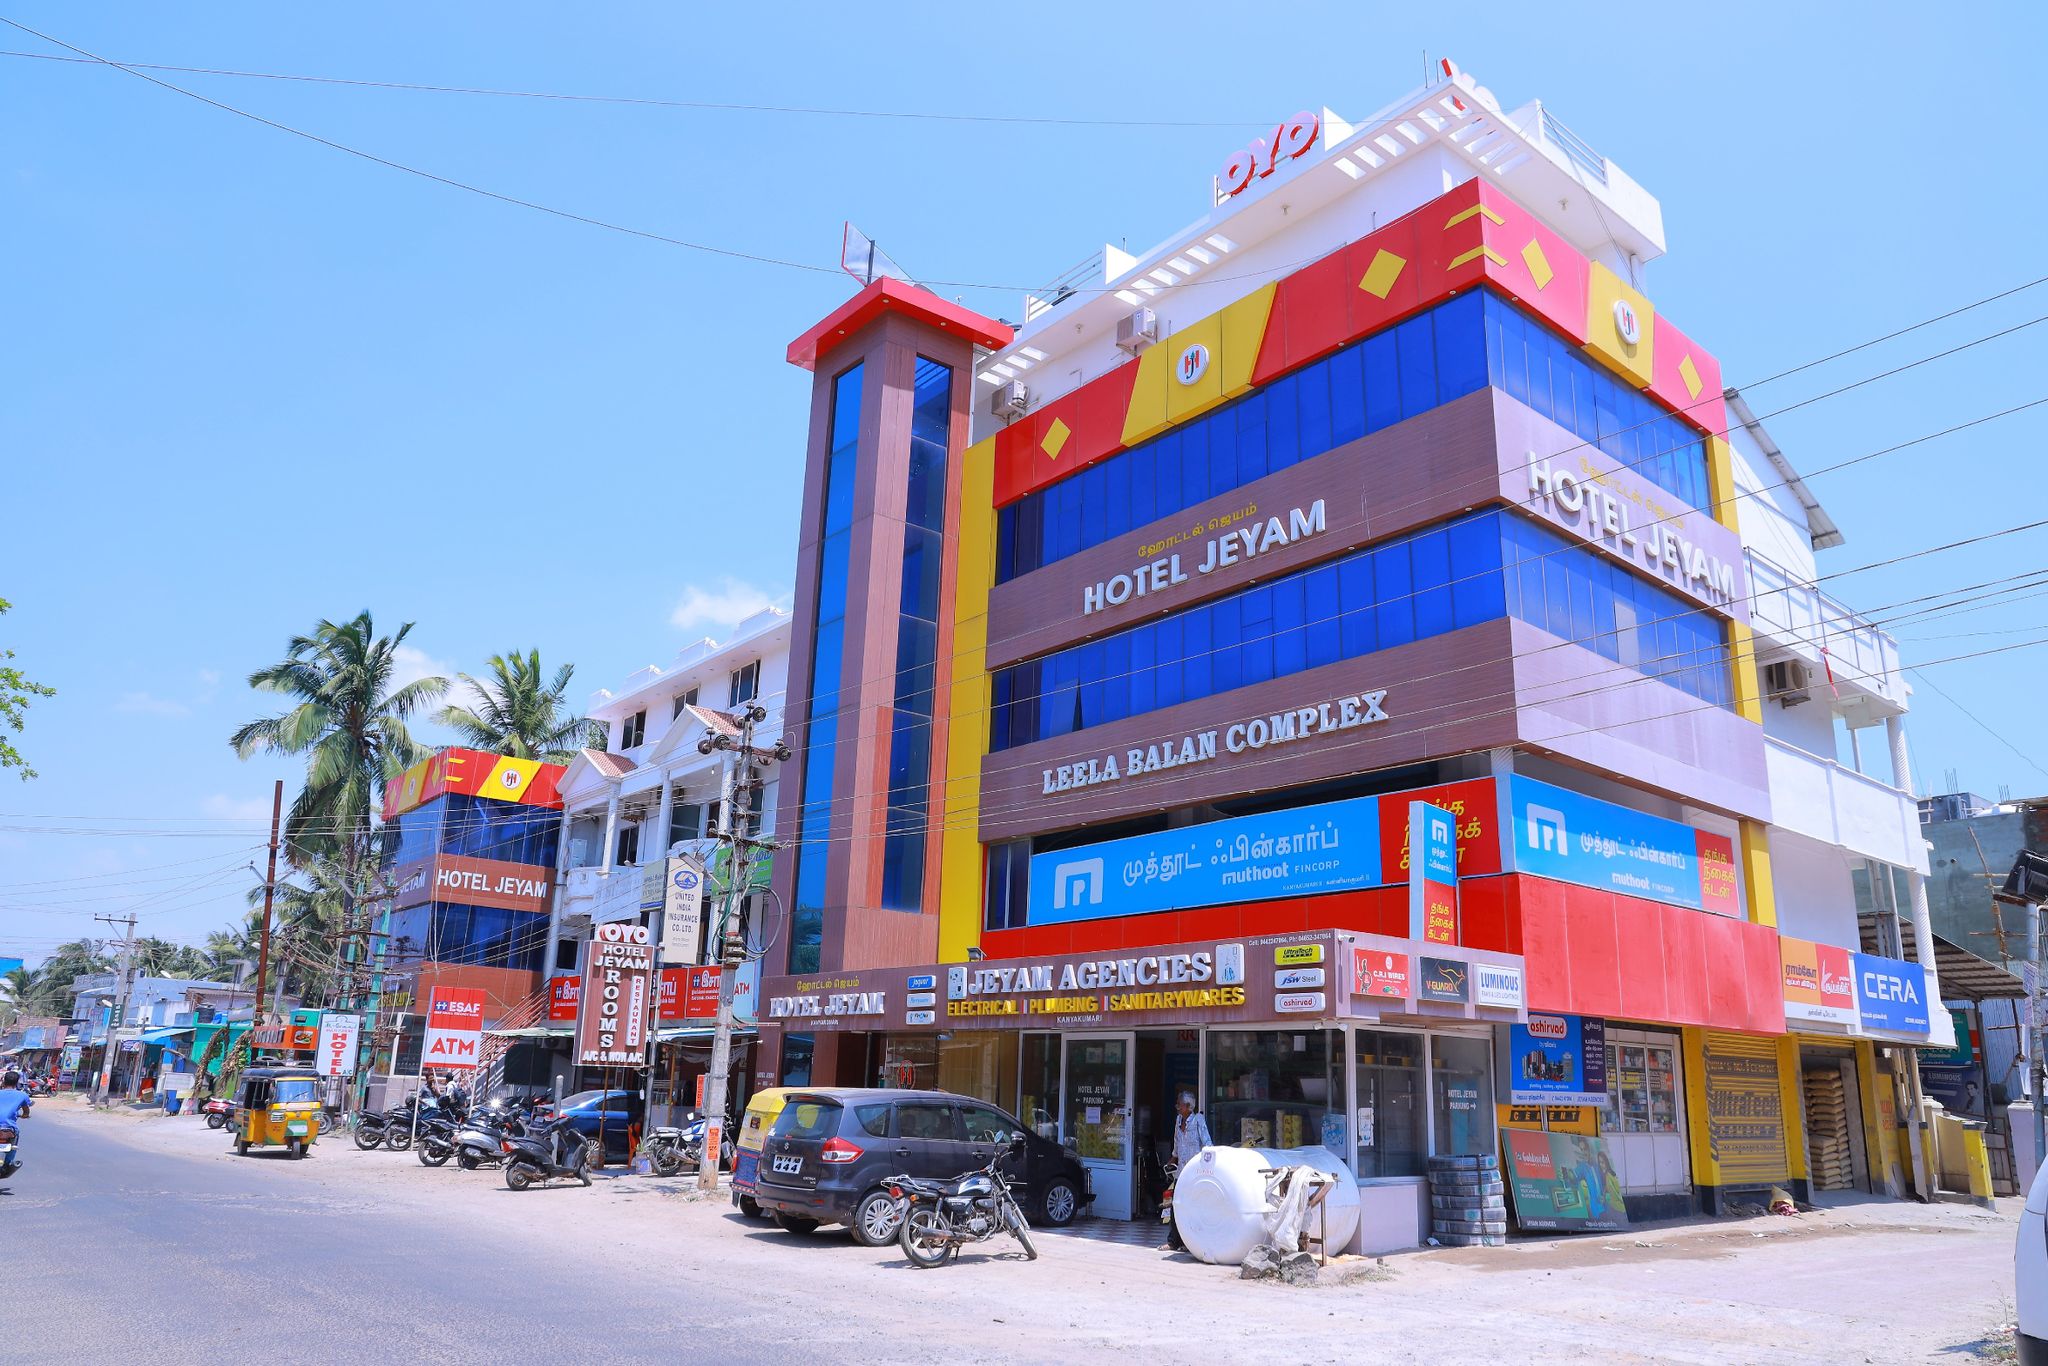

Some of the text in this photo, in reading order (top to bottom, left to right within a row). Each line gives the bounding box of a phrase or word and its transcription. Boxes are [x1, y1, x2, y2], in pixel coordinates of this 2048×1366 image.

[1218, 111, 1319, 197] OYO
[1209, 502, 1257, 531] ஜெயம்
[1527, 450, 1736, 602] HOTEL JEYAM
[1084, 499, 1326, 615] HOTEL JEYAM
[1043, 690, 1389, 794] LEELA BALAN COMPLEX
[1222, 860, 1340, 886] muthoot FINCORP
[1612, 872, 1650, 890] muthoot
[437, 869, 547, 898] HOTEL JEYAM
[675, 892, 695, 902] UNITED
[676, 904, 691, 912] INDIA
[668, 913, 698, 924] INSURANCE
[601, 923, 650, 944] OYO
[604, 945, 646, 958] HOTEL
[1283, 947, 1314, 956] UltraTech
[594, 956, 649, 970] JEYAM
[968, 952, 1213, 995] JEYAM AGENCIES
[1281, 975, 1301, 986] JSW
[1480, 972, 1519, 992] LUMINOUS
[734, 983, 750, 995] ATM
[1863, 971, 1919, 1005] CERA
[449, 1001, 480, 1013] ESAF
[599, 970, 621, 1048] ROOMS
[769, 992, 885, 1017] HOTEL JEYAM
[947, 987, 1246, 1017] ELECTRICAL PLUMBING SANITARYWARES
[1284, 997, 1313, 1007] ashirvad
[1056, 1015, 1103, 1024] KANYAKUMARI
[1530, 1020, 1564, 1034] ashirvad
[330, 1033, 347, 1075] HOTEL
[430, 1037, 475, 1055] ATM
[600, 1051, 607, 1062] &
[1927, 1071, 1961, 1081] LUMINOUS
[1082, 1097, 1105, 1105] PARKING
[1449, 1101, 1470, 1110] PARKING
